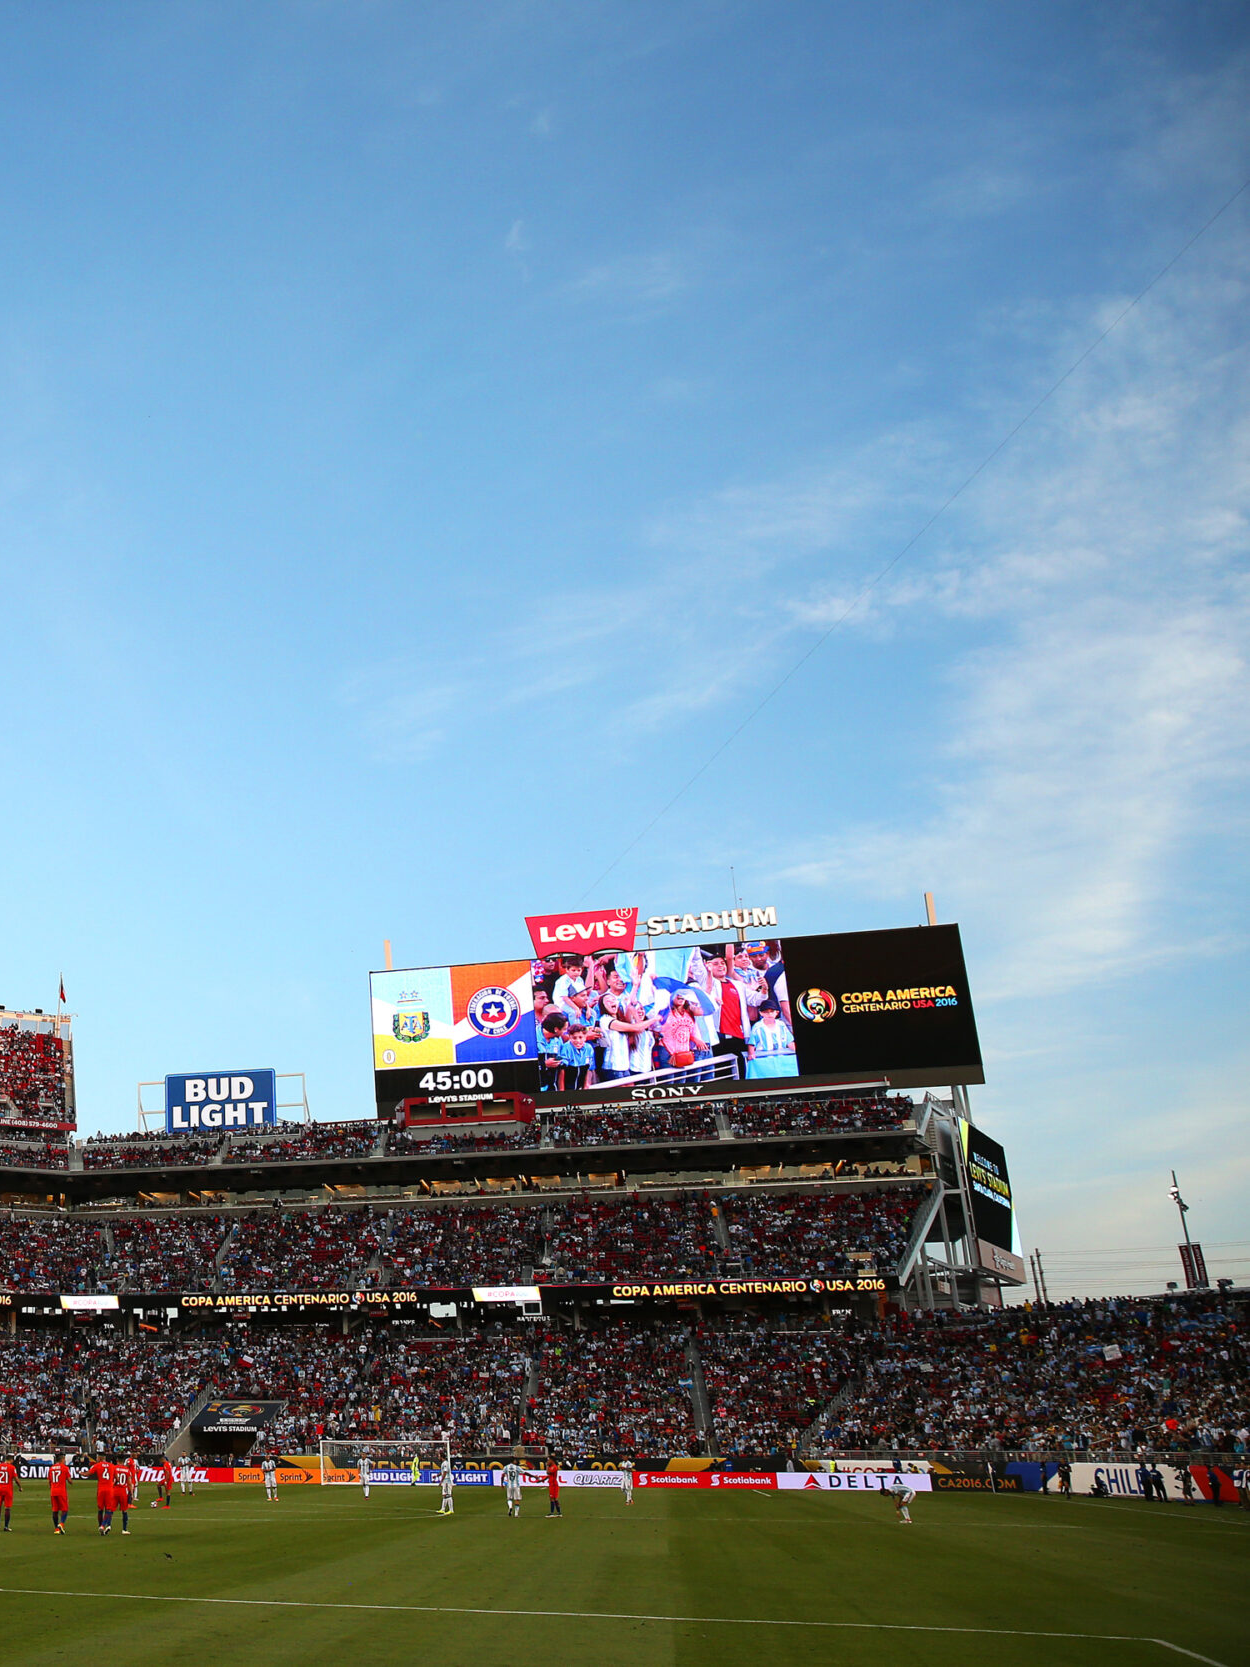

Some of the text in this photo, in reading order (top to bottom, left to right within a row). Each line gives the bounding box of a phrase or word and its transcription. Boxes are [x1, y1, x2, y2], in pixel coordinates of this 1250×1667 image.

[647, 906, 777, 936] STADIUM
[841, 985, 957, 1004] COPA AMERICA
[842, 997, 958, 1014] CENTENARIO USA 2016
[513, 1041, 527, 1056] 0
[382, 1050, 395, 1064] 0
[419, 1068, 494, 1091] 45:00
[185, 1076, 255, 1103] BUD
[631, 1085, 704, 1100] SONY
[459, 1093, 493, 1102] STADIUM
[172, 1101, 268, 1129] LIGHT
[11, 1119, 28, 1127] (408)
[612, 1278, 886, 1297] COPA AMERICA CENTENARIO USA 2016
[181, 1292, 417, 1307] COPA AMERICA CENTENARIO USA 2016
[0, 1471, 9, 1484] 21
[20, 1465, 89, 1479] SAMNG
[51, 1470, 61, 1483] 17
[102, 1468, 110, 1480] 4
[238, 1472, 261, 1482] Sprint
[280, 1473, 303, 1482] Sprint
[368, 1472, 389, 1482] BUD
[456, 1473, 488, 1482] LIGHT
[573, 1474, 623, 1485] QUARTZ
[651, 1475, 698, 1484] Scotiabank
[723, 1476, 772, 1485] Scotiabank
[829, 1475, 903, 1488] DELTA
